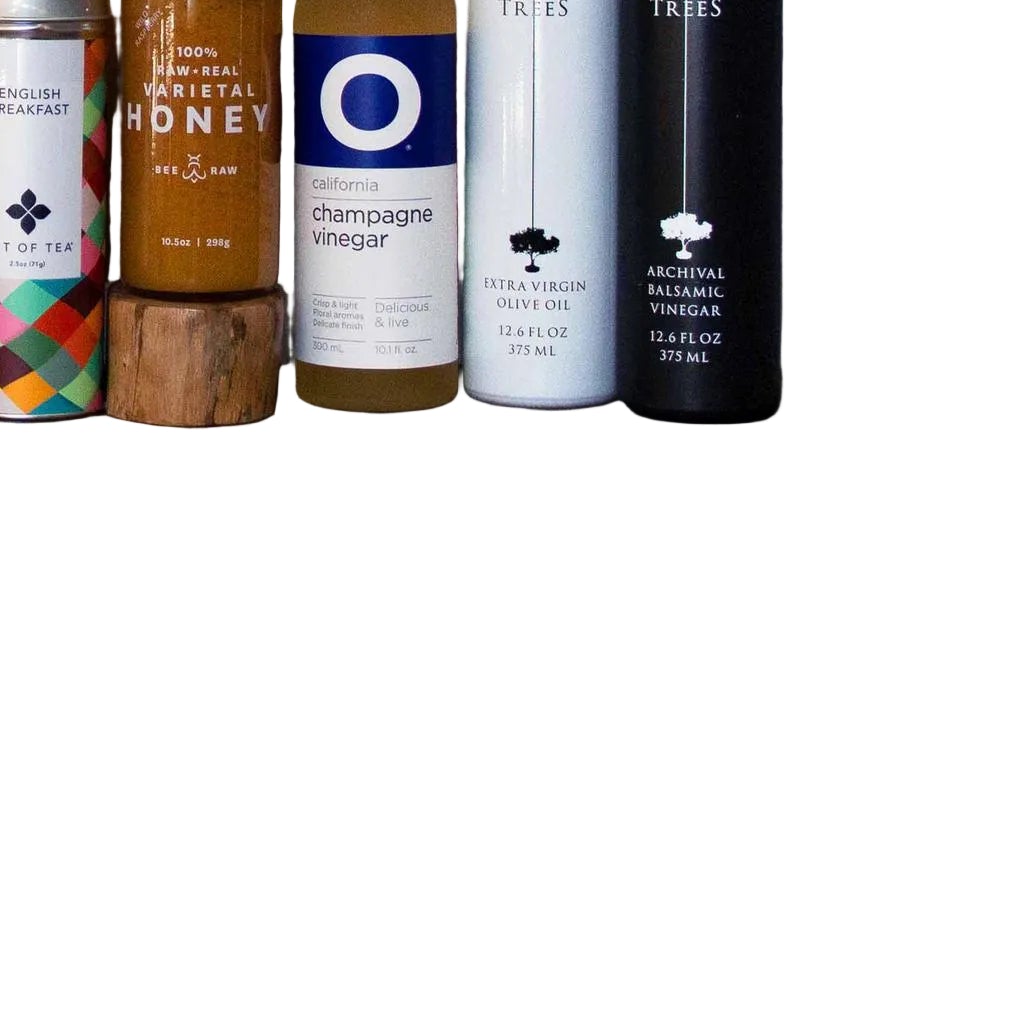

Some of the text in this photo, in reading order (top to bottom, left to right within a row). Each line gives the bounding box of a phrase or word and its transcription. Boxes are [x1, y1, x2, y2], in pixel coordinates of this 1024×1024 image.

[176, 46, 218, 58] 100%
[156, 65, 239, 77] RAW REAL
[0, 87, 61, 100] ENGLISH
[143, 82, 255, 98] VARIETAL
[320, 53, 422, 151] O
[127, 102, 268, 134] HONEY
[154, 165, 238, 175] BEE RAW
[312, 177, 379, 193] california
[312, 203, 433, 228] champagne
[161, 237, 191, 247] 10.5oz
[206, 238, 231, 249] 298g
[312, 228, 389, 251] vinegar
[17, 242, 38, 253] OF
[647, 265, 725, 280] ARCHIVAL
[484, 277, 587, 292] EXTRA VIRGIN
[648, 283, 725, 299] BALSAMIC
[312, 298, 330, 309] Crisp
[338, 300, 358, 311] light
[496, 297, 571, 311] OLIVE OIL
[650, 302, 722, 318] VINEGAR
[312, 318, 364, 331] Delicate finish
[374, 316, 409, 328] & live
[499, 324, 568, 338] 12.6 FL OZ
[650, 330, 722, 344] 12.6 FL OZ
[312, 340, 329, 351] 300
[508, 344, 556, 357] 375 ML
[659, 349, 709, 363] 375 ML
